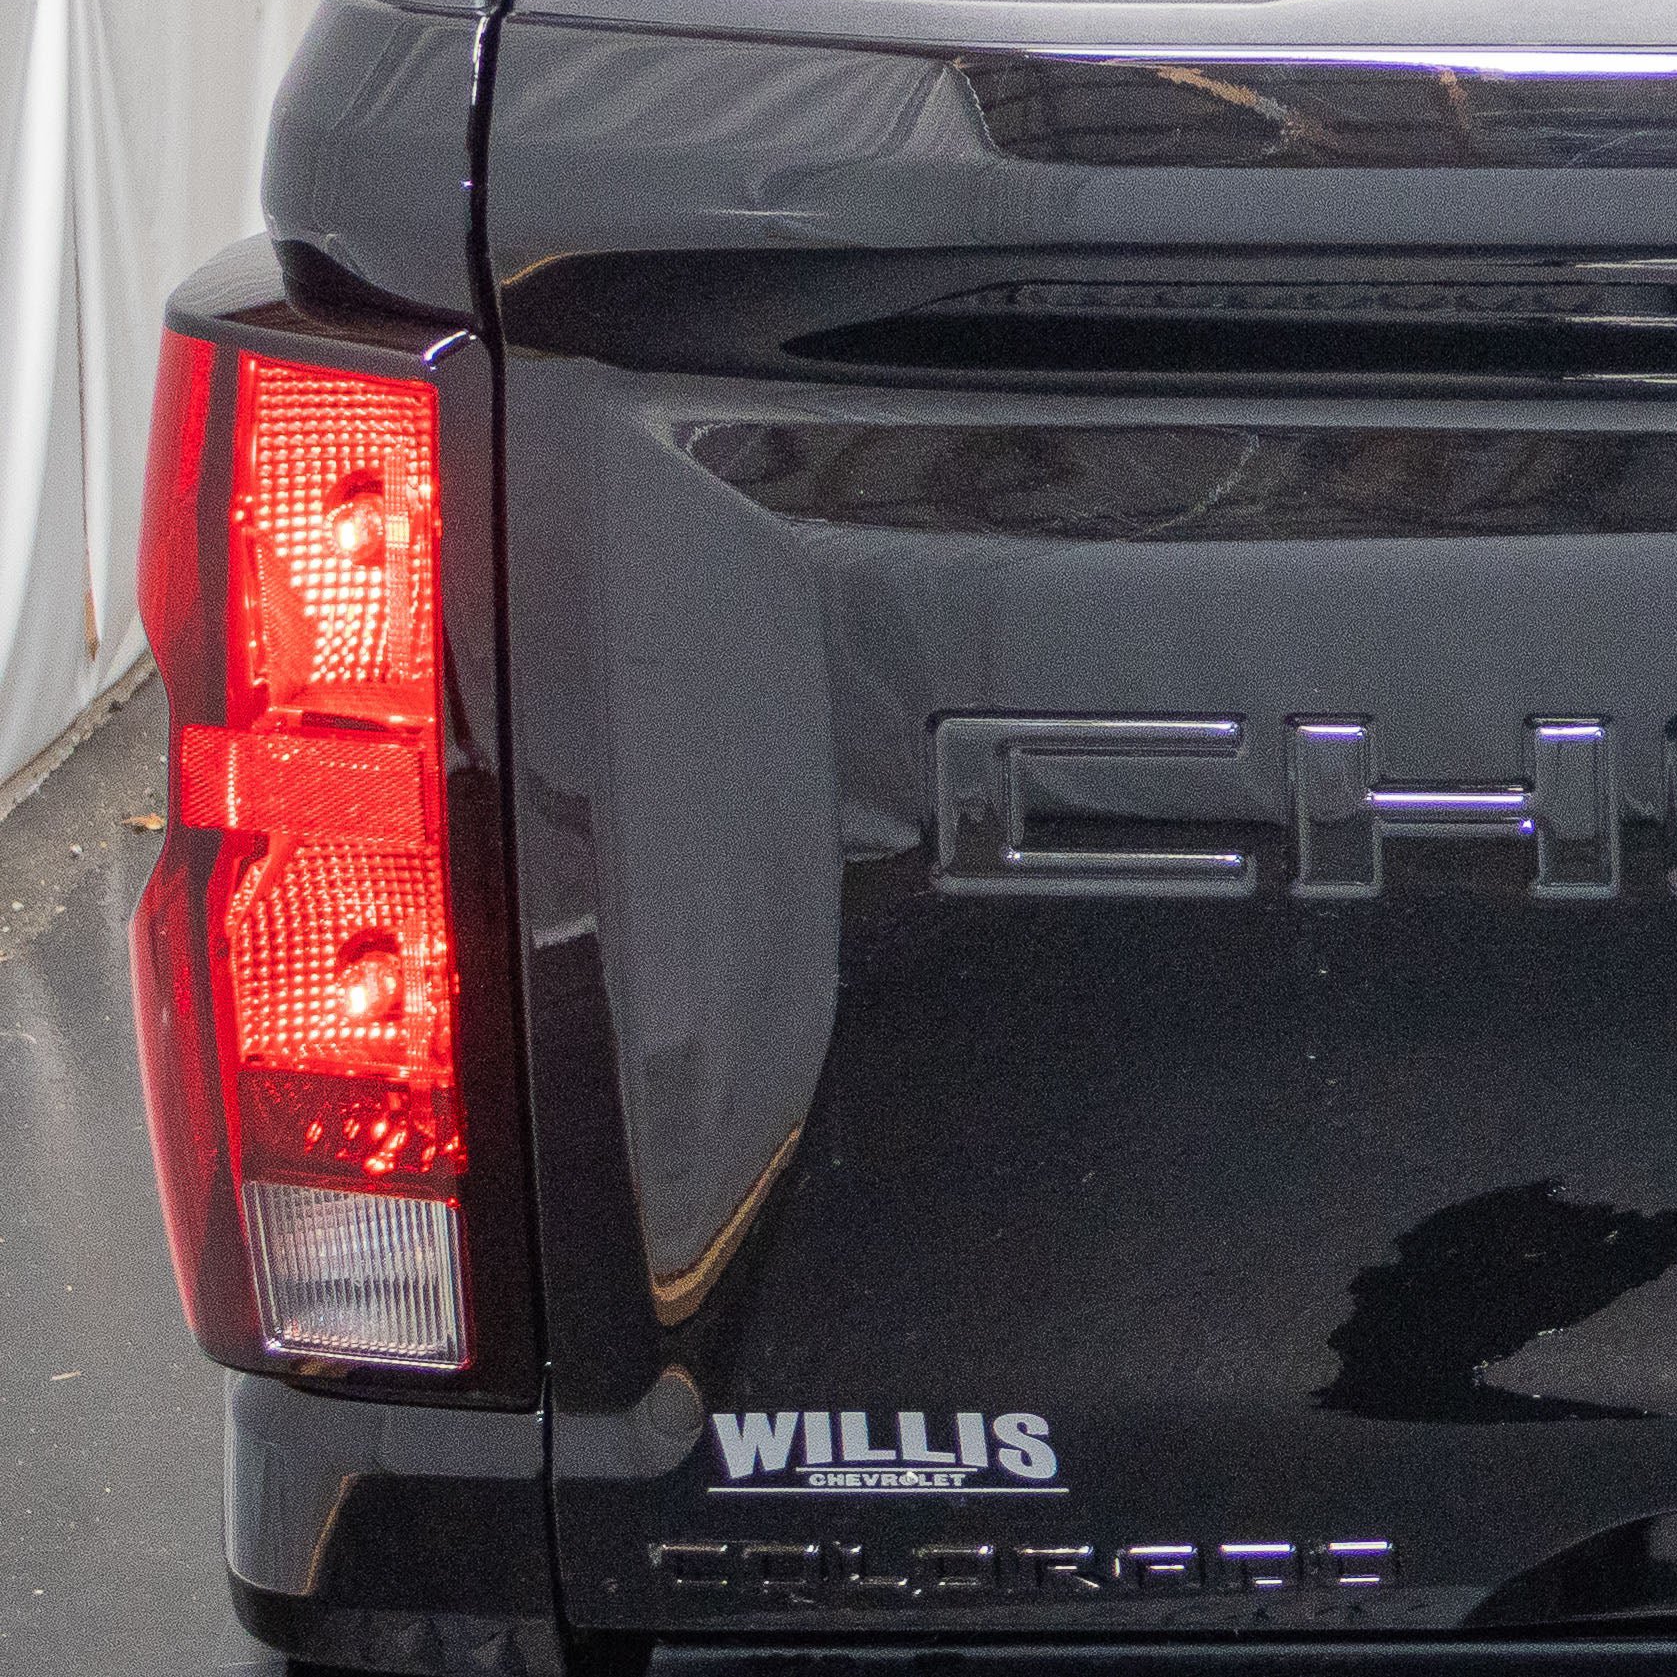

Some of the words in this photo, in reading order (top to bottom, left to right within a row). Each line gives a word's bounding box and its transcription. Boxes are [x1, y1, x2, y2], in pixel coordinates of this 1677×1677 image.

[711, 1411, 1058, 1479] WILLIS
[808, 1471, 967, 1487] CHEVROLET
[648, 1539, 1396, 1595] COLORADO
